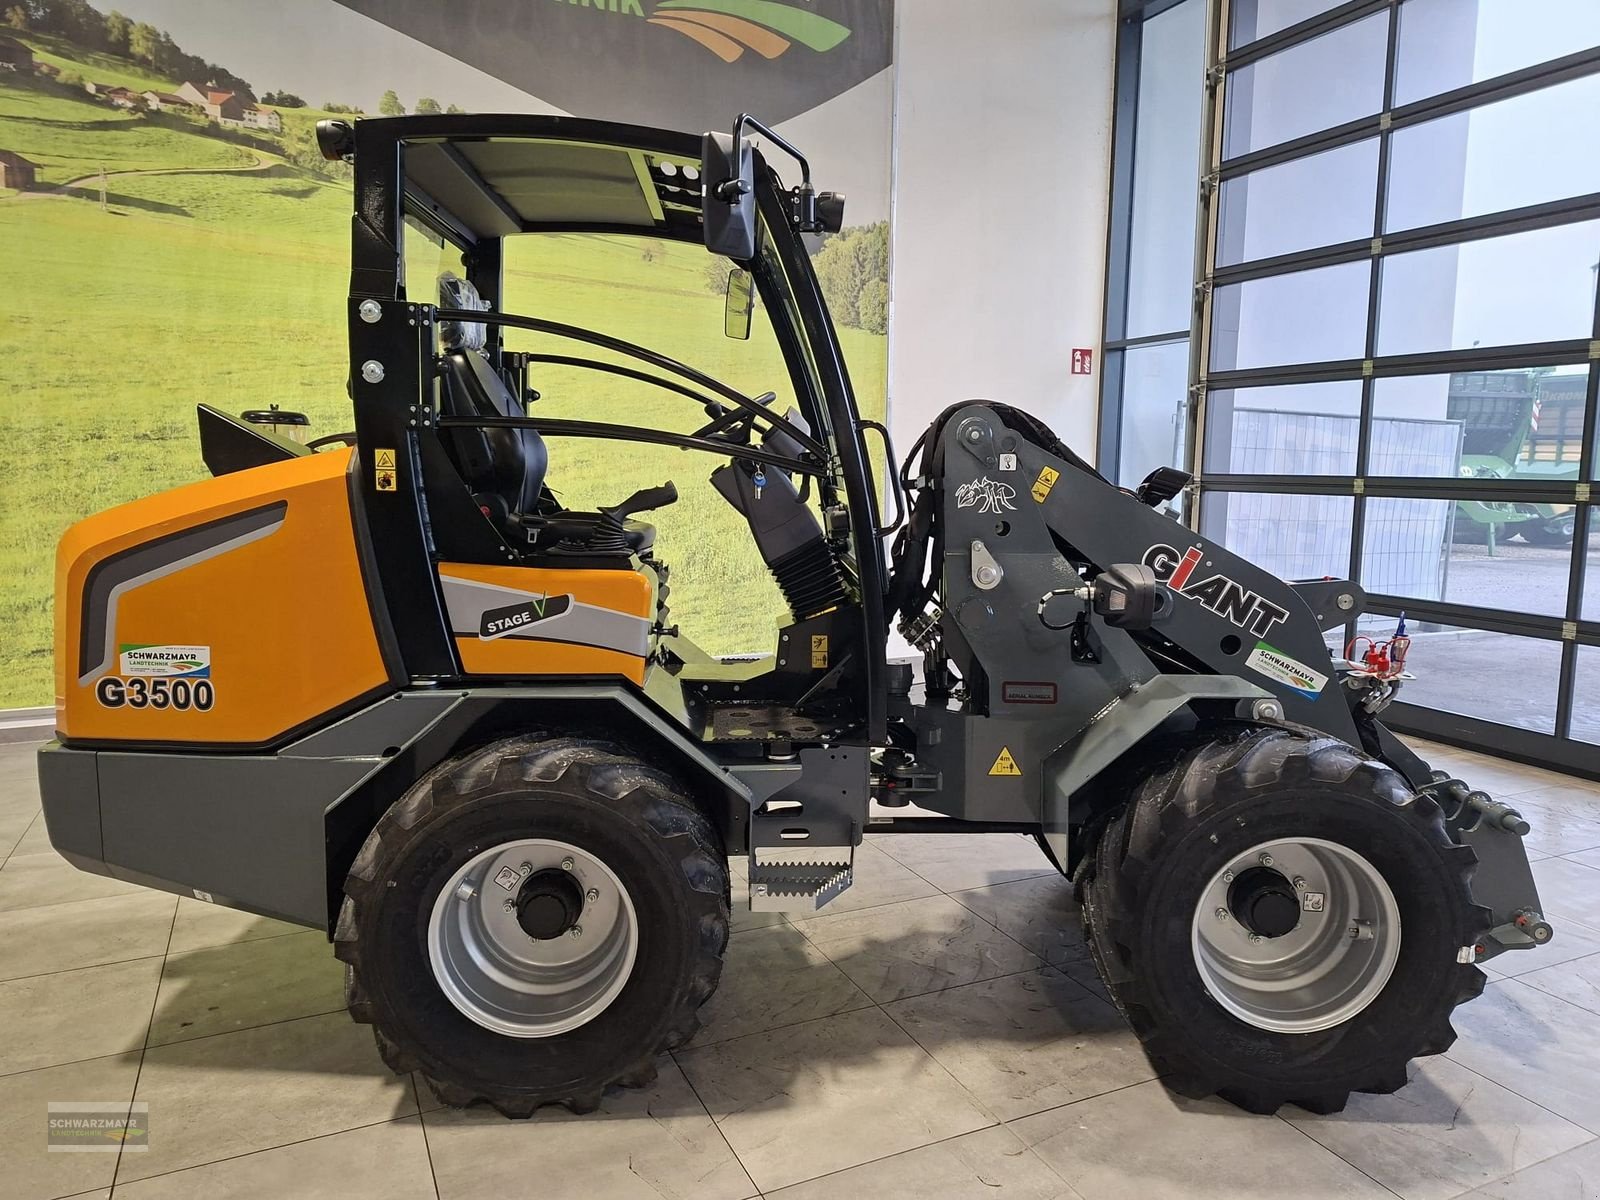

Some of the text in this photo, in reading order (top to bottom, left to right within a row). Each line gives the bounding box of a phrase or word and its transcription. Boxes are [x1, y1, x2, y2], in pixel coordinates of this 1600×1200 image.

[487, 590, 547, 633] STAGE V
[128, 652, 197, 660] SCHWARZMAYR
[1259, 650, 1315, 683] SCHWARZMAYR
[96, 676, 215, 712] G3500
